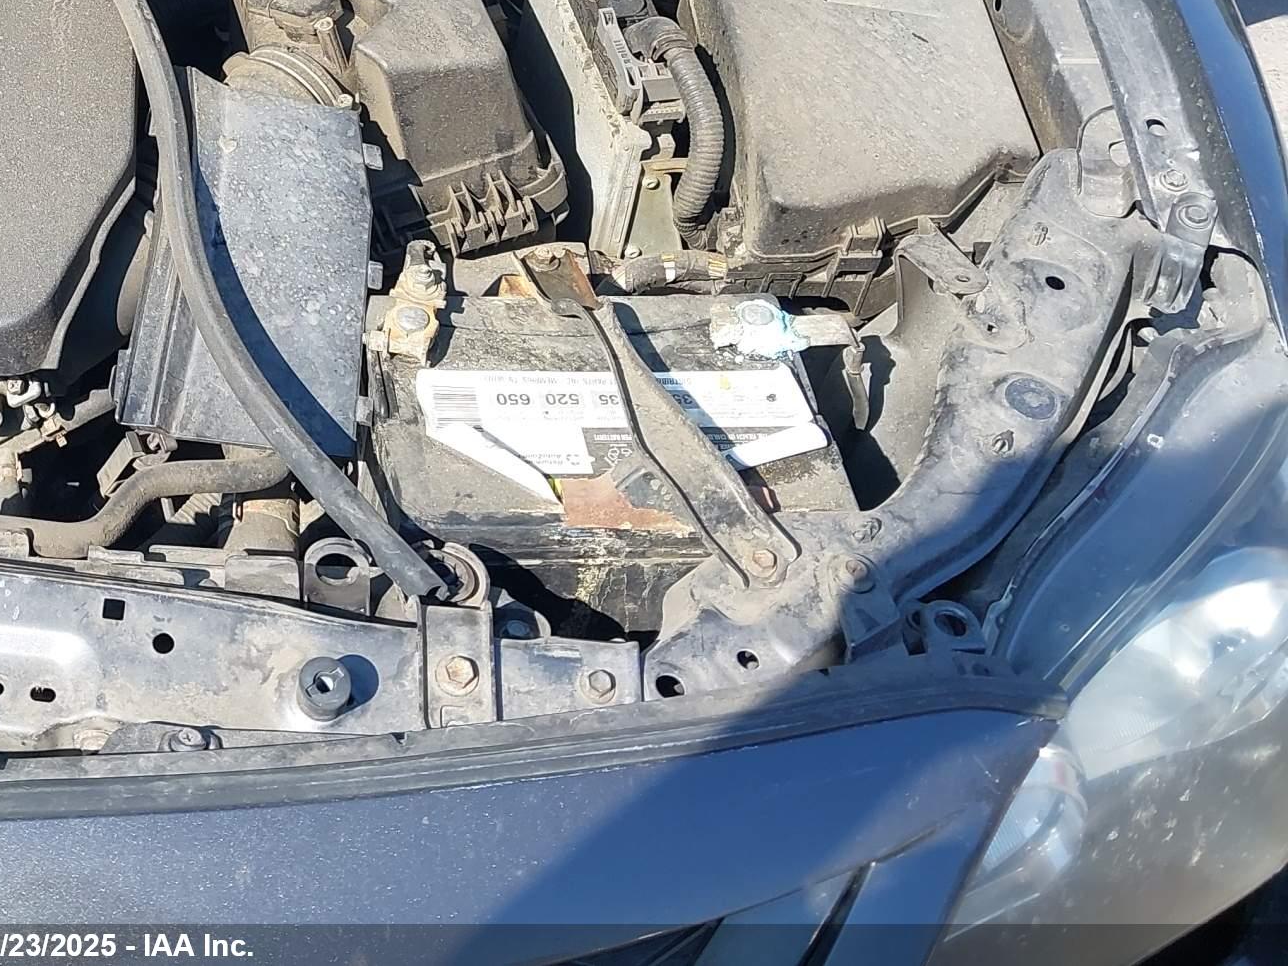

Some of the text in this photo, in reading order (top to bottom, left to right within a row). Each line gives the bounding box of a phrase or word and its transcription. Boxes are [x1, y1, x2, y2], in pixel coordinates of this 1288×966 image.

[495, 392, 620, 405] 35 520 650
